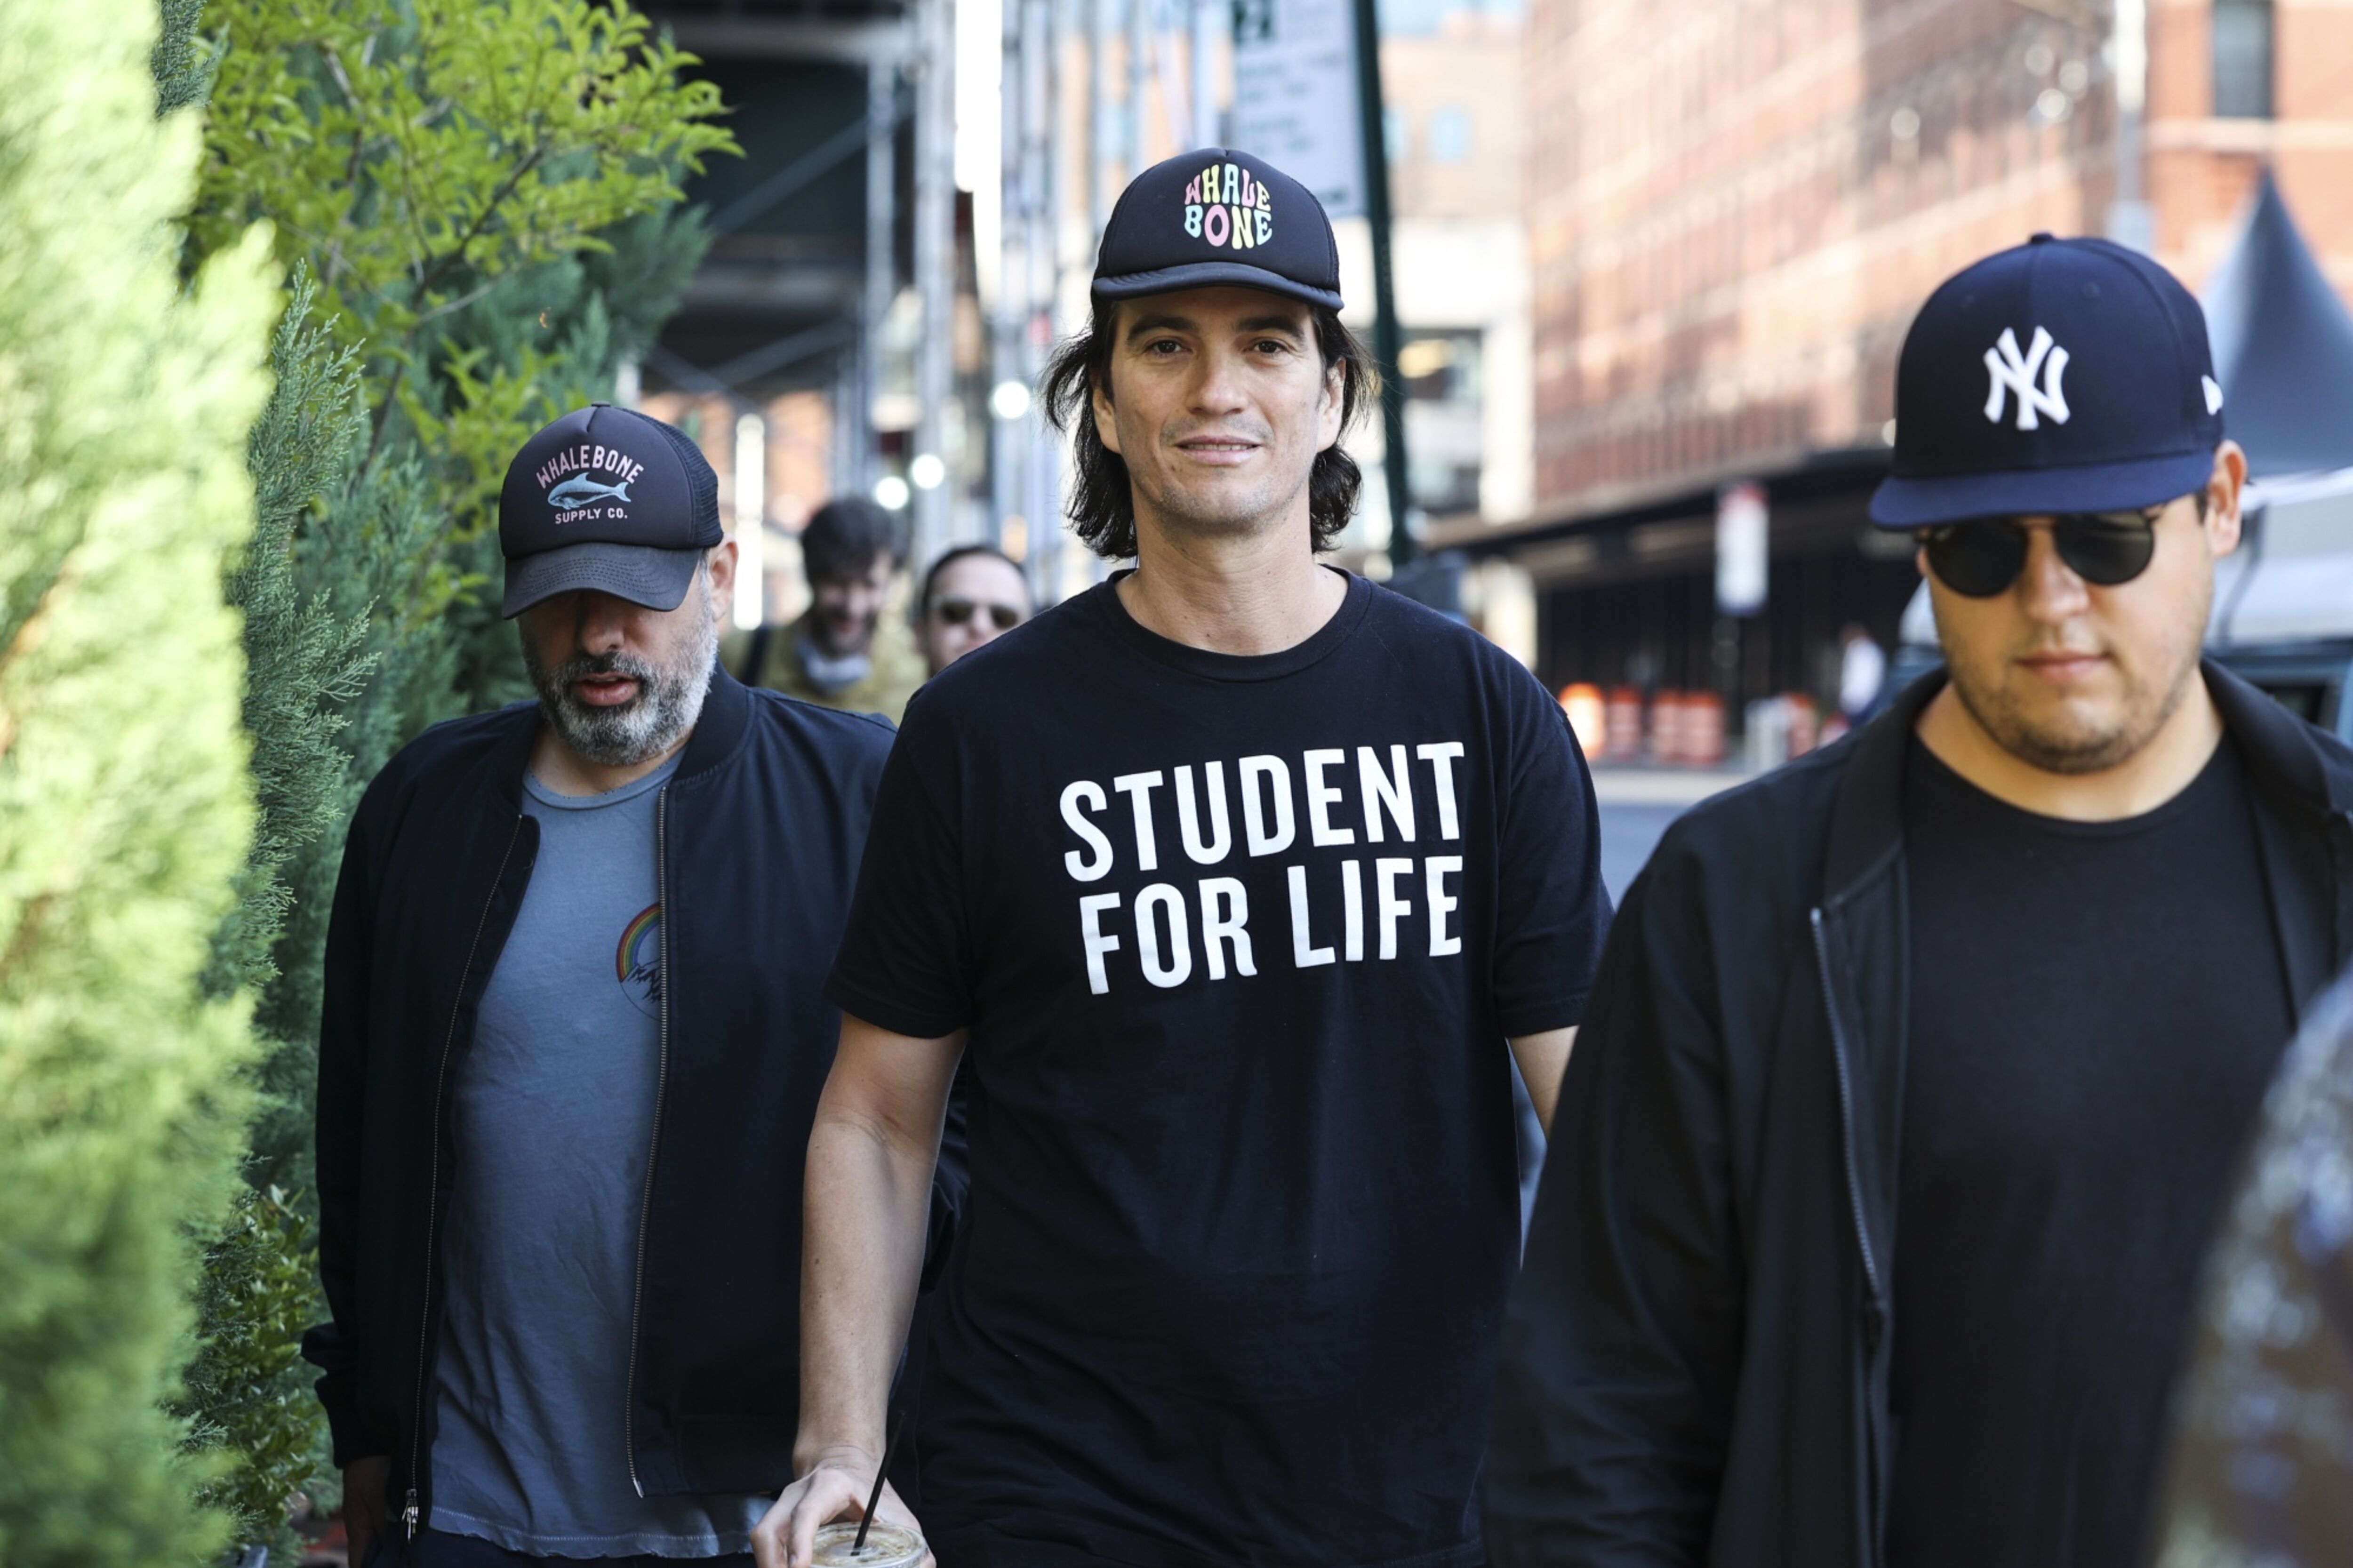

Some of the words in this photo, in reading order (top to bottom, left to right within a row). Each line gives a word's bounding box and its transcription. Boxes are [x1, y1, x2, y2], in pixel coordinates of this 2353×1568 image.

[1185, 163, 1271, 212] WHALE
[1184, 204, 1272, 249] BONE
[1983, 326, 2070, 431] NY
[536, 445, 644, 488] WHALEBONE
[555, 508, 601, 524] SUPPLY
[608, 508, 627, 519] CO.
[1059, 742, 1465, 882] STUDENT
[1080, 877, 1257, 995] FOR
[1287, 856, 1463, 968] LIFE
